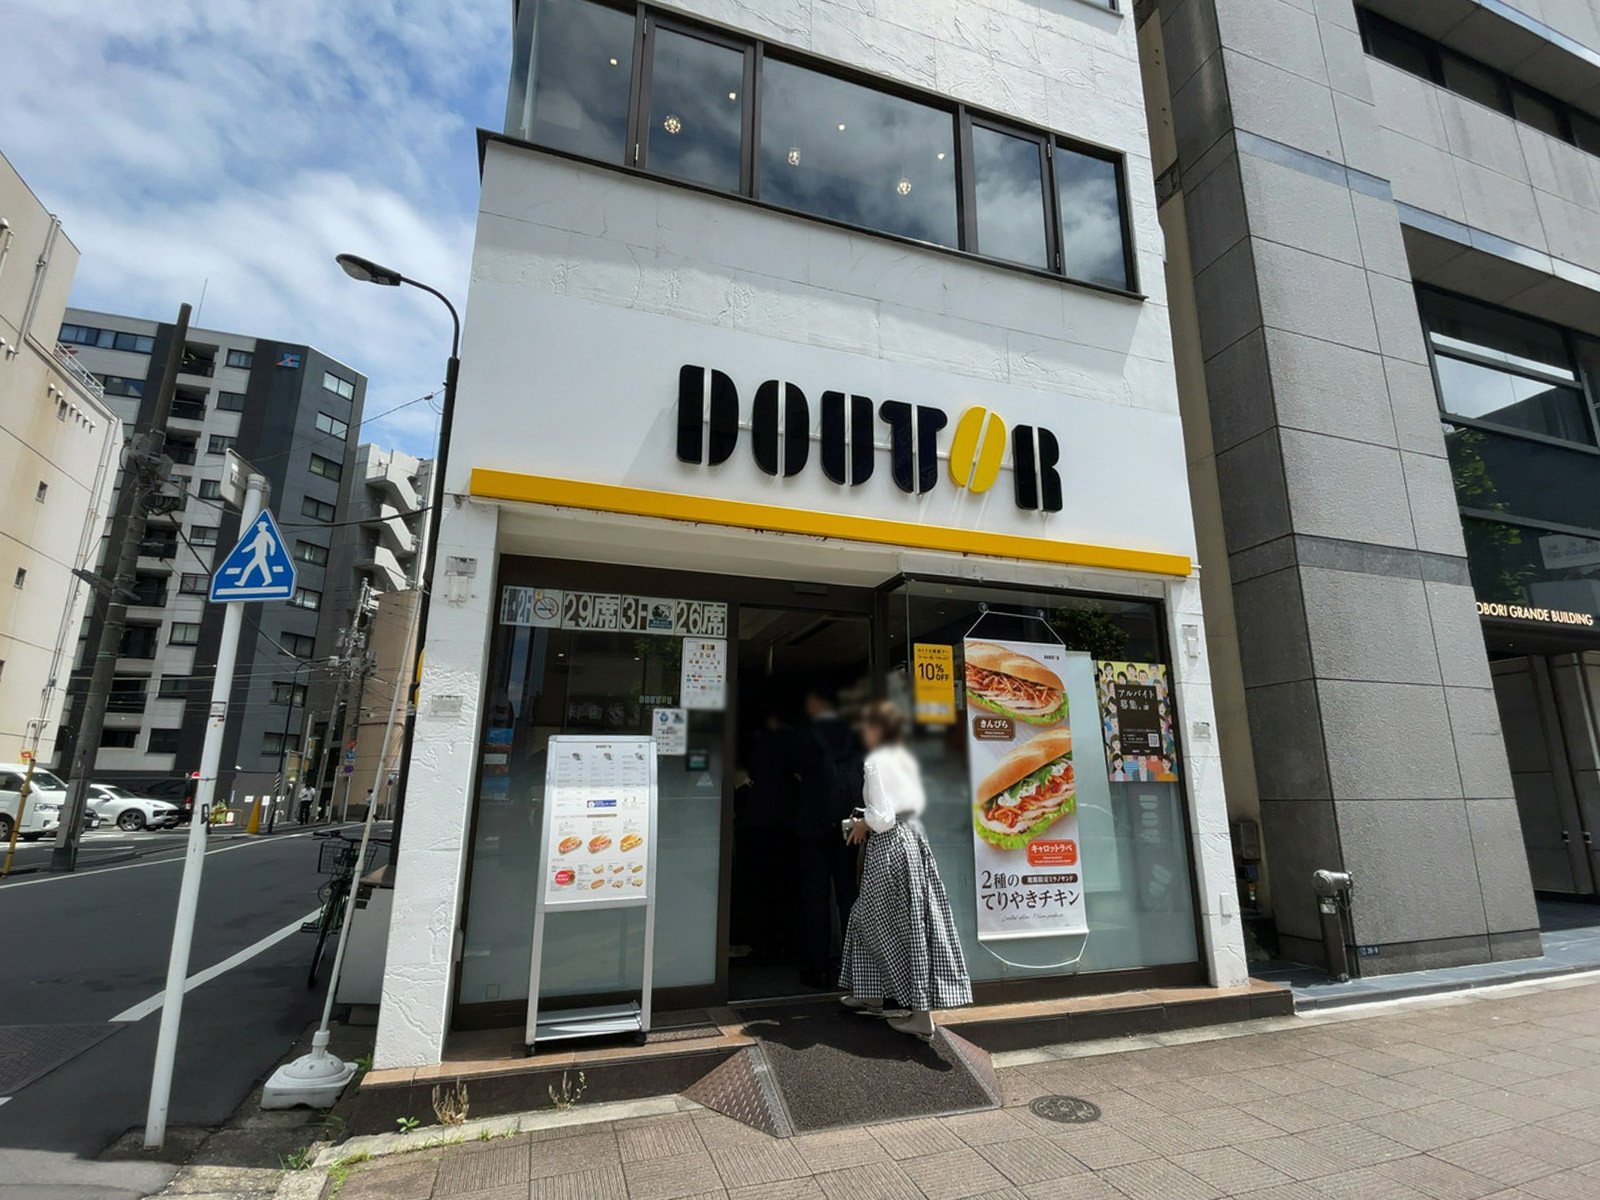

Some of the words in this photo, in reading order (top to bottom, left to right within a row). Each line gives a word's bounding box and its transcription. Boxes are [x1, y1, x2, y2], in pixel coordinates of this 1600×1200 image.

[677, 364, 1063, 514] DOUTOR
[564, 593, 621, 630] 29席
[621, 597, 649, 631] 3F
[676, 601, 726, 636] 26席
[1509, 605, 1550, 622] GRANDE
[1551, 610, 1594, 626] BUILDING
[935, 673, 950, 682] OFF
[1118, 689, 1154, 699] アルバイト
[981, 870, 1019, 889] 2種の
[981, 889, 1080, 911] てりやきチキン
